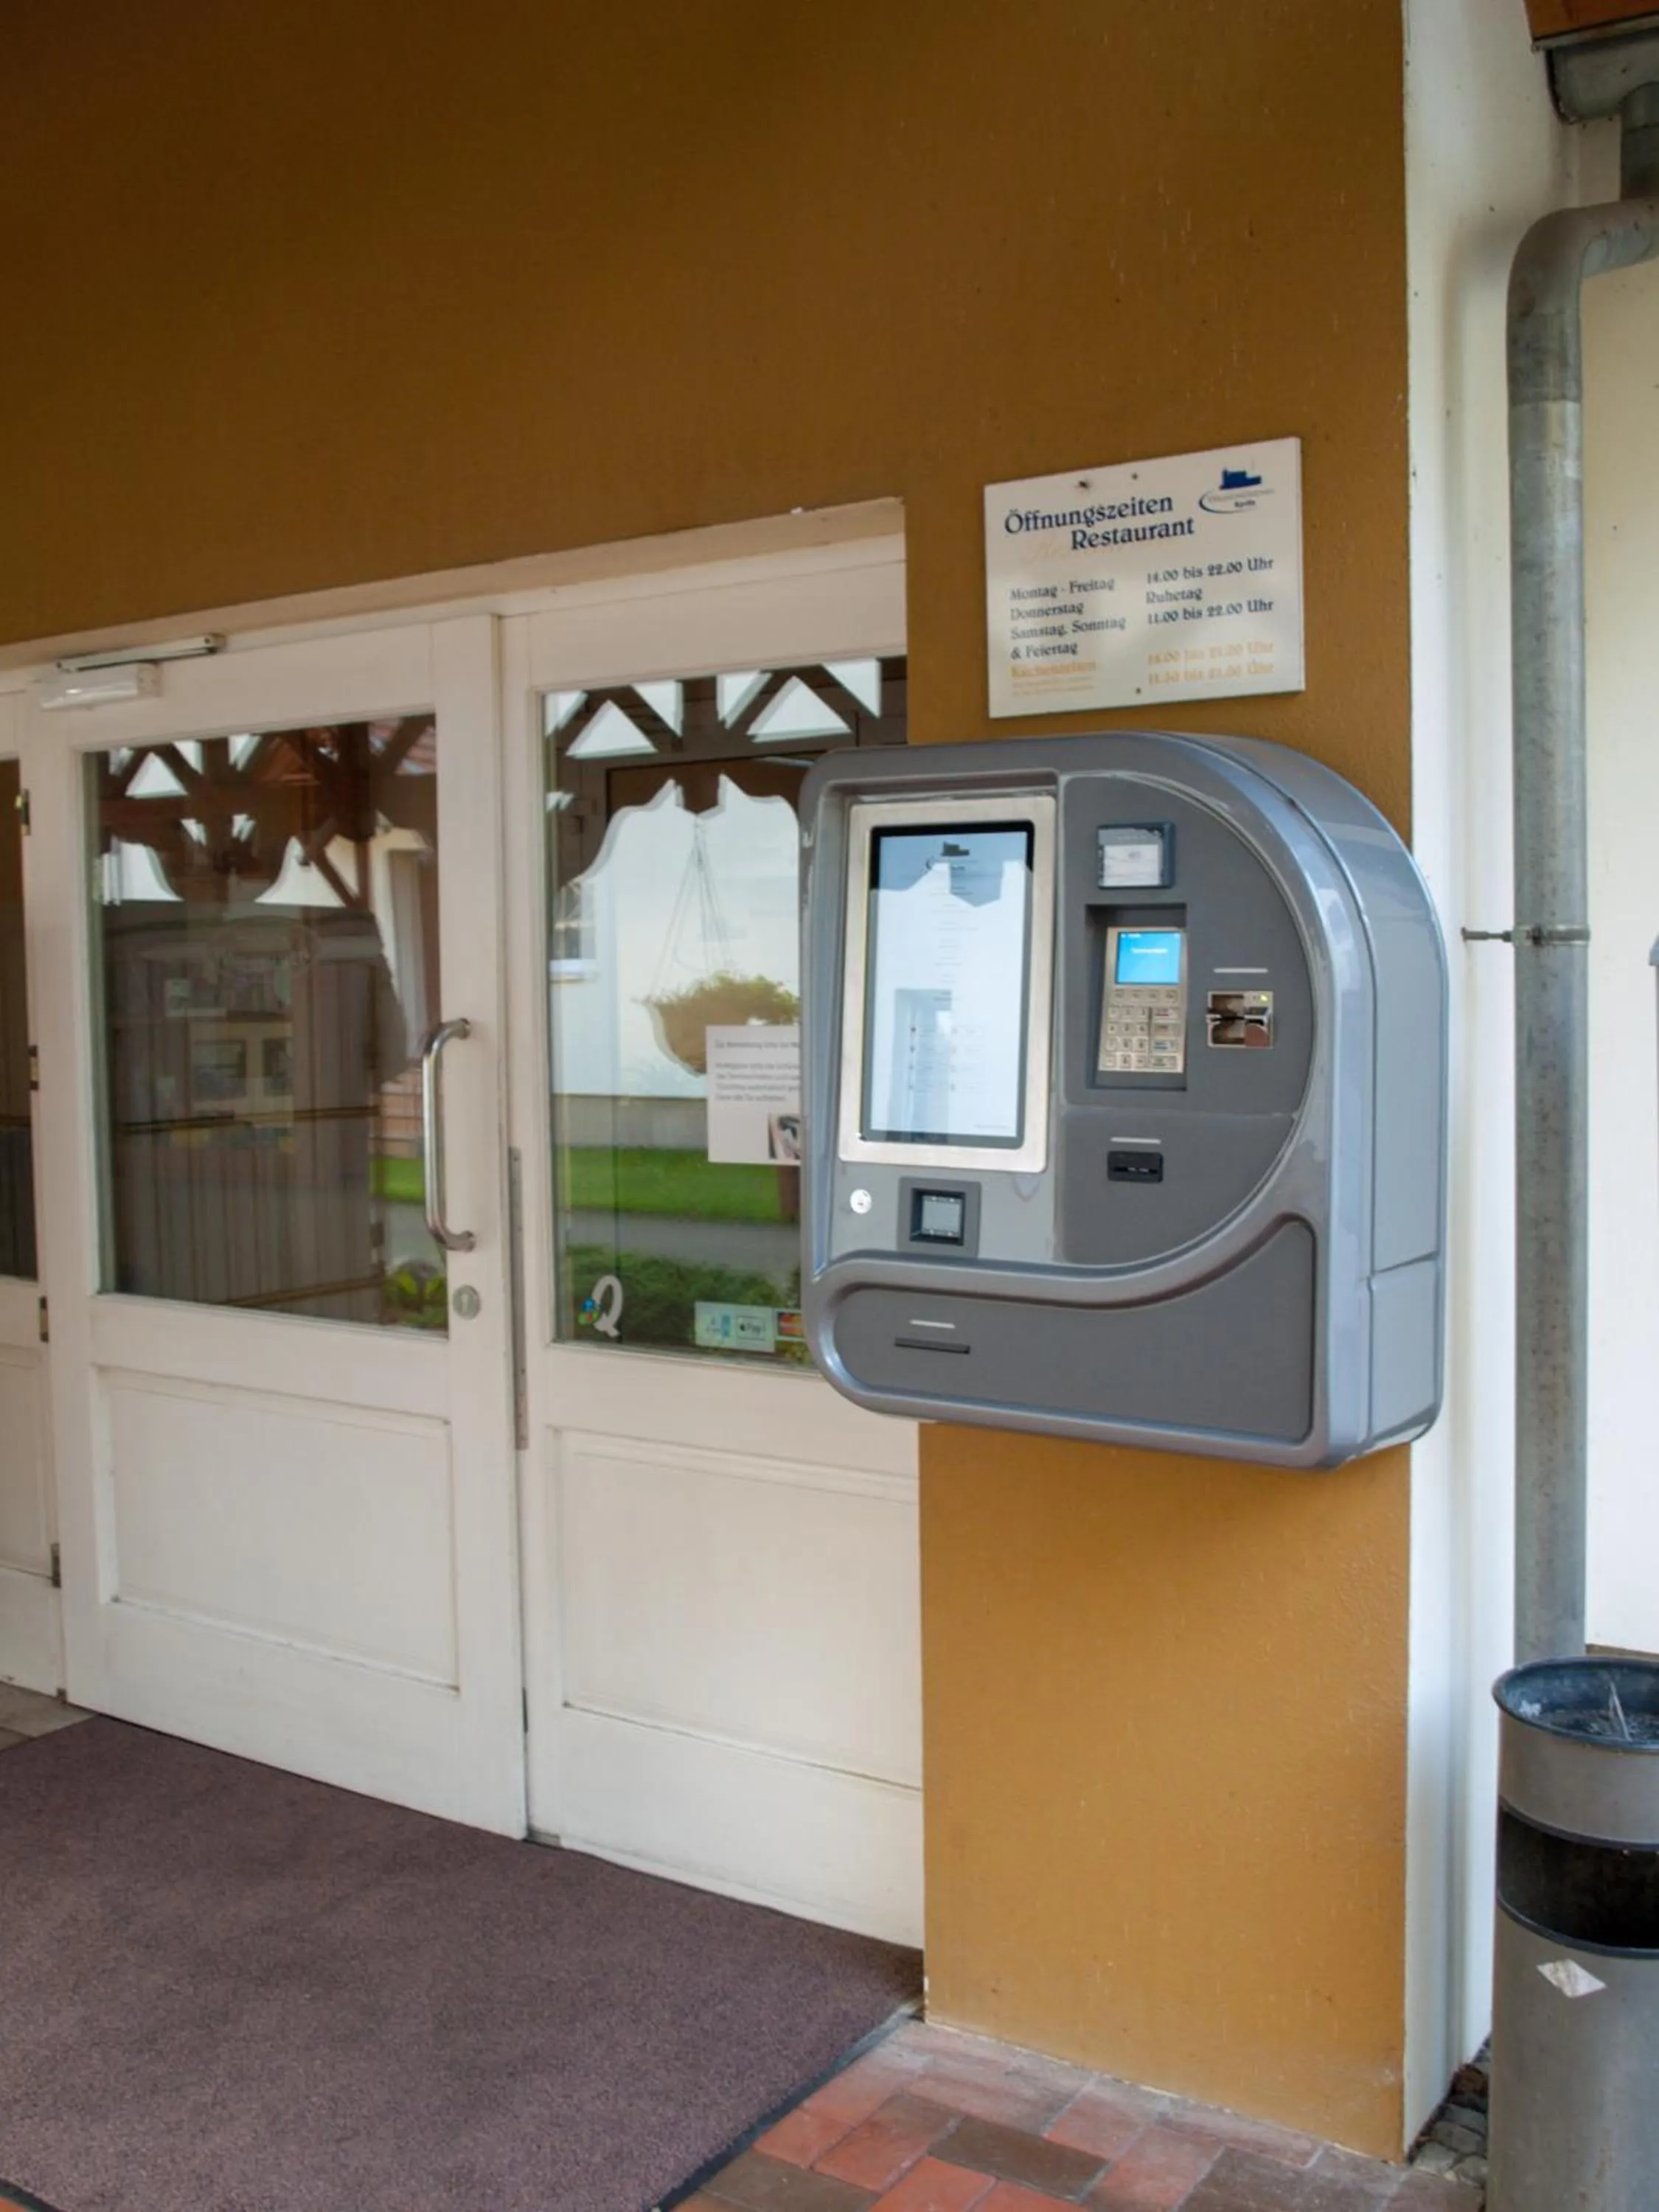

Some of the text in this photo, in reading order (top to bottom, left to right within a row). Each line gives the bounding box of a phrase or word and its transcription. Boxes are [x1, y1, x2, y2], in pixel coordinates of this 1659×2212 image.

[1004, 496, 1173, 535] Öffnungszeiten
[1071, 518, 1194, 551] Restaurant
[1010, 586, 1058, 601] Montag
[1069, 579, 1115, 594] Freitag
[1147, 569, 1178, 584] 14.00
[1183, 566, 1203, 579] bis
[1206, 561, 1243, 576] 22.00
[1247, 557, 1274, 571] Uhr
[1010, 588, 1203, 621] Donnerstag Ruhetag
[1071, 618, 1126, 633] Sonntag
[1148, 611, 1178, 625] 11.00
[1183, 608, 1203, 620] bis
[1206, 603, 1243, 617] 22.00
[1247, 599, 1274, 613] Uhr
[1011, 643, 1078, 660] & Feiertag
